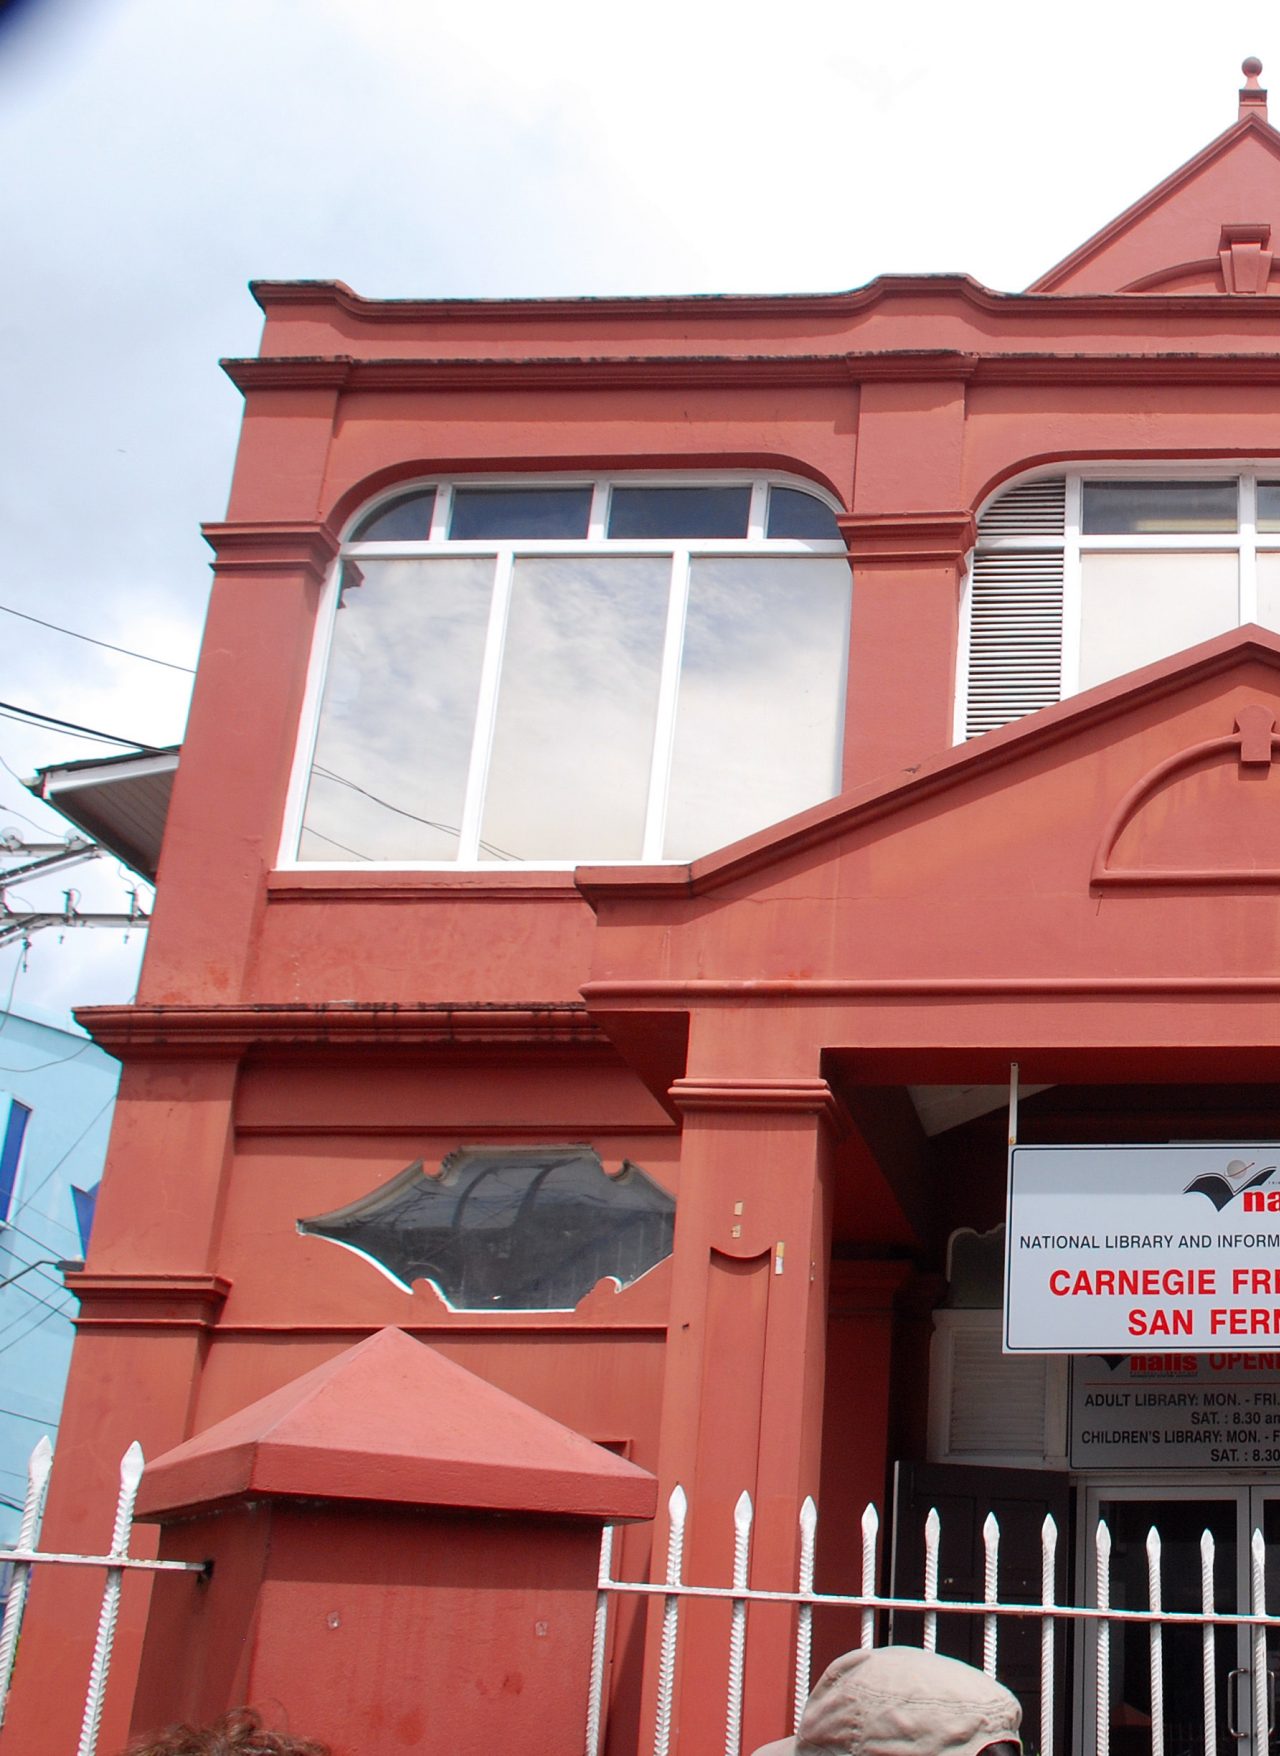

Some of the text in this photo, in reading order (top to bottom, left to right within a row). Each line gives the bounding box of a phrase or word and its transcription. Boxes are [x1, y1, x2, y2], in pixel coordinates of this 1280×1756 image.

[1021, 1236, 1099, 1248] NATIONAL
[1106, 1236, 1172, 1248] LIBRARY
[1179, 1236, 1211, 1248] AND
[1050, 1270, 1215, 1296] CARNEGIE
[1129, 1310, 1192, 1335] SAN
[1085, 1394, 1131, 1406] ADULT
[1135, 1393, 1199, 1406] LIBRARY:
[1203, 1393, 1240, 1406] MON.
[1191, 1412, 1219, 1424] SAT.
[1233, 1412, 1260, 1424] 8.30
[1082, 1431, 1160, 1444] CHILDREN'S
[1165, 1431, 1222, 1443] LIBRARY:
[1227, 1430, 1260, 1443] MON.
[1211, 1449, 1239, 1462] SAT.
[1253, 1449, 1280, 1461] 8.30
